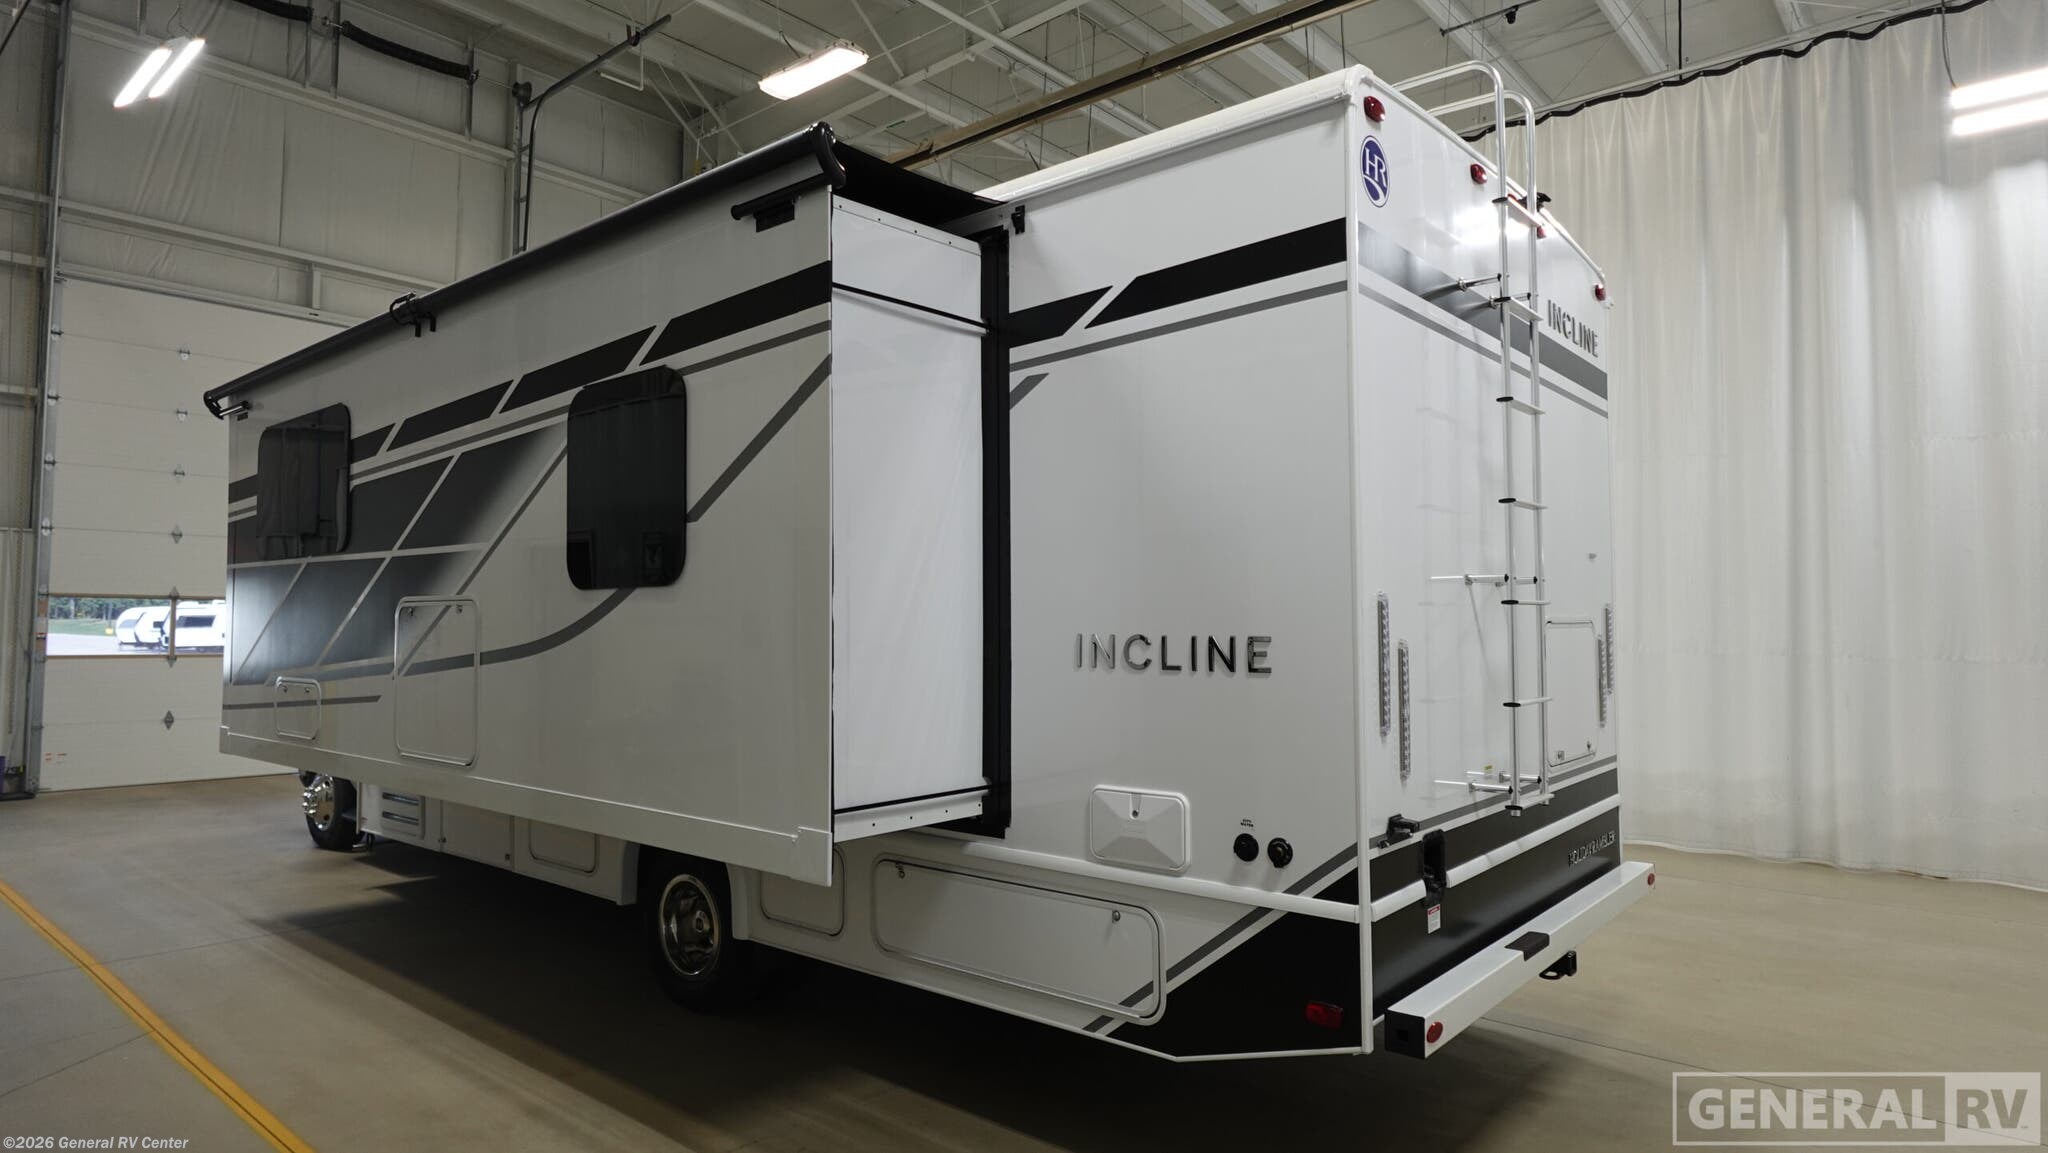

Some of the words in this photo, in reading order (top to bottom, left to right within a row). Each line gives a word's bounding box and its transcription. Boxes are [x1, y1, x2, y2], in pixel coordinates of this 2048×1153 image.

[1364, 147, 1387, 188] HR
[1547, 299, 1598, 358] INCLINE
[1075, 633, 1272, 674] INCLINE
